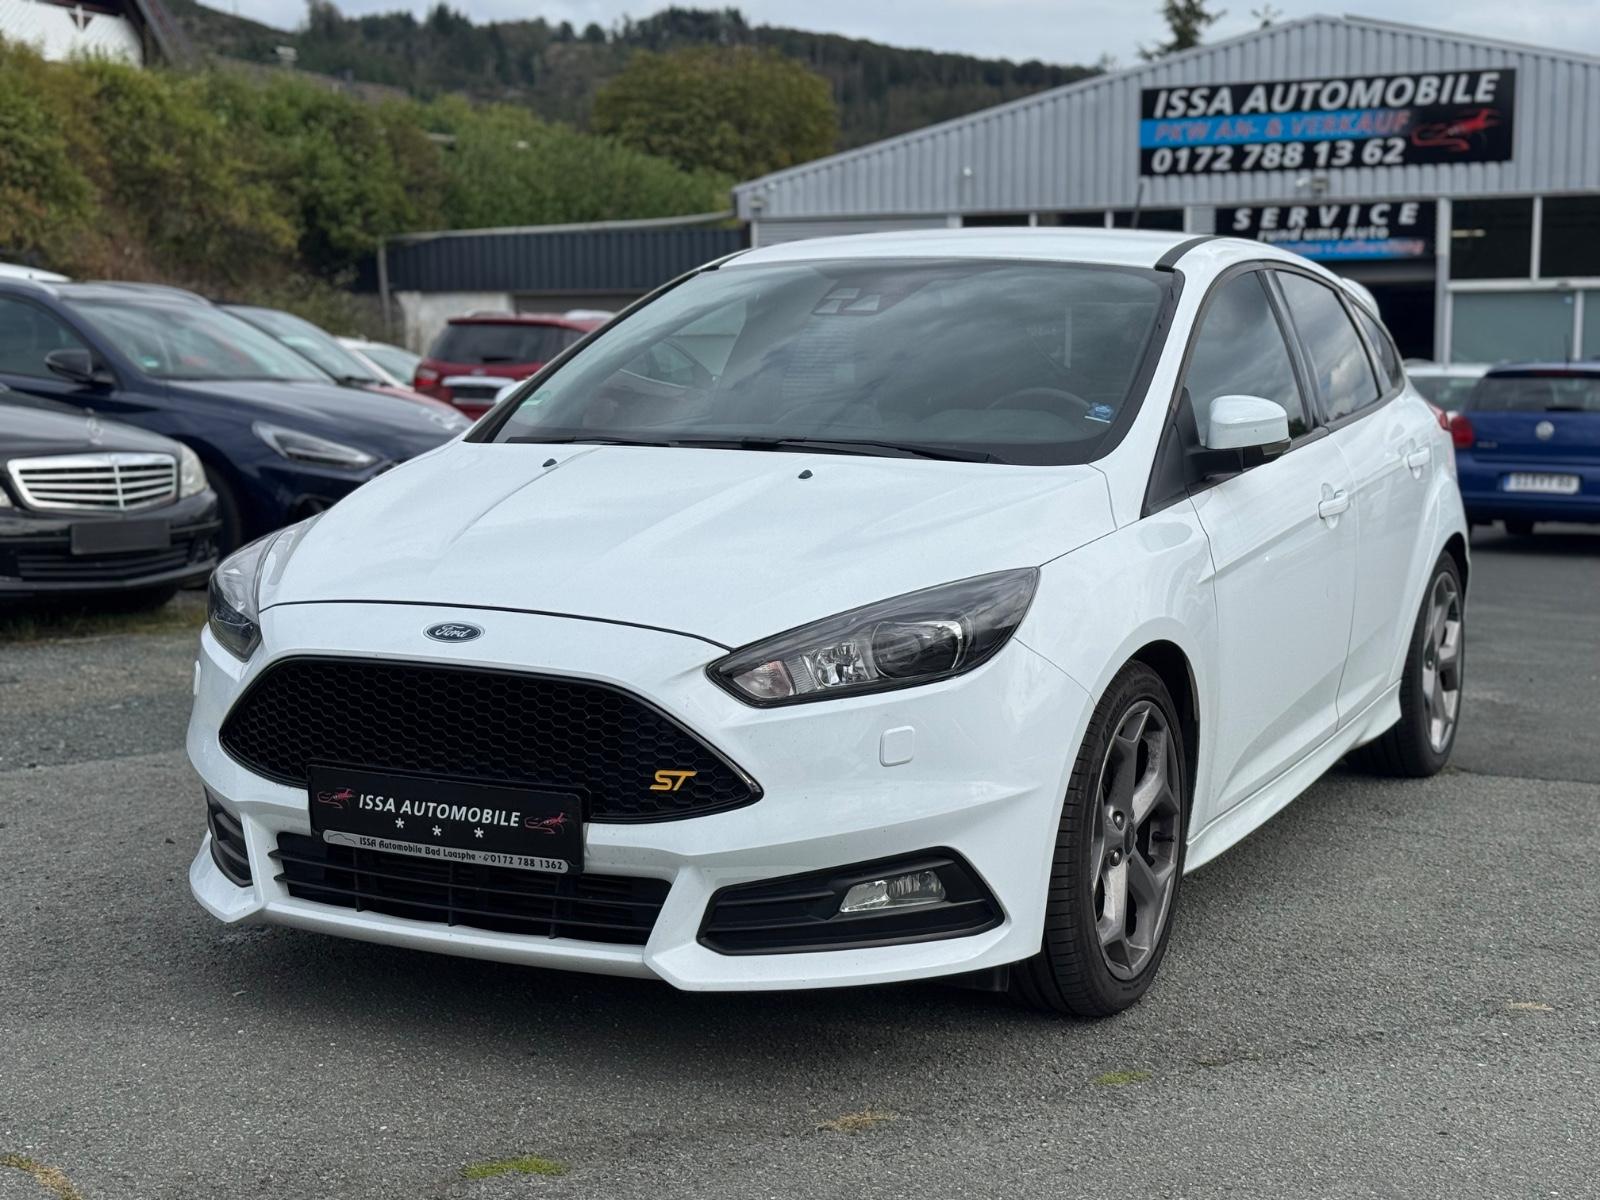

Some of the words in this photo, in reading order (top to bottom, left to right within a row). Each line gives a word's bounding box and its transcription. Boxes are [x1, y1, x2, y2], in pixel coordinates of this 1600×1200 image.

[1153, 87, 1233, 119] ISSA
[1240, 71, 1500, 114] AUTOMOBILE
[1265, 117, 1283, 138] &
[1291, 109, 1412, 136] VERKAUF
[1151, 144, 1234, 174] 0172
[1240, 141, 1305, 170] 788
[1313, 139, 1355, 167] 13
[1361, 136, 1406, 165] 62
[1232, 202, 1420, 231] SERVICE
[1342, 225, 1390, 240] Auto
[435, 624, 471, 638] Ford
[649, 769, 698, 791] ST
[359, 793, 396, 813] ISSA
[400, 799, 521, 827] AUTOMOBILE
[359, 836, 377, 848] ISSA
[379, 840, 422, 854] Automobile
[425, 846, 440, 856] Bad
[490, 854, 514, 865] 0172
[517, 857, 535, 867] 788
[539, 860, 563, 870] 1362
